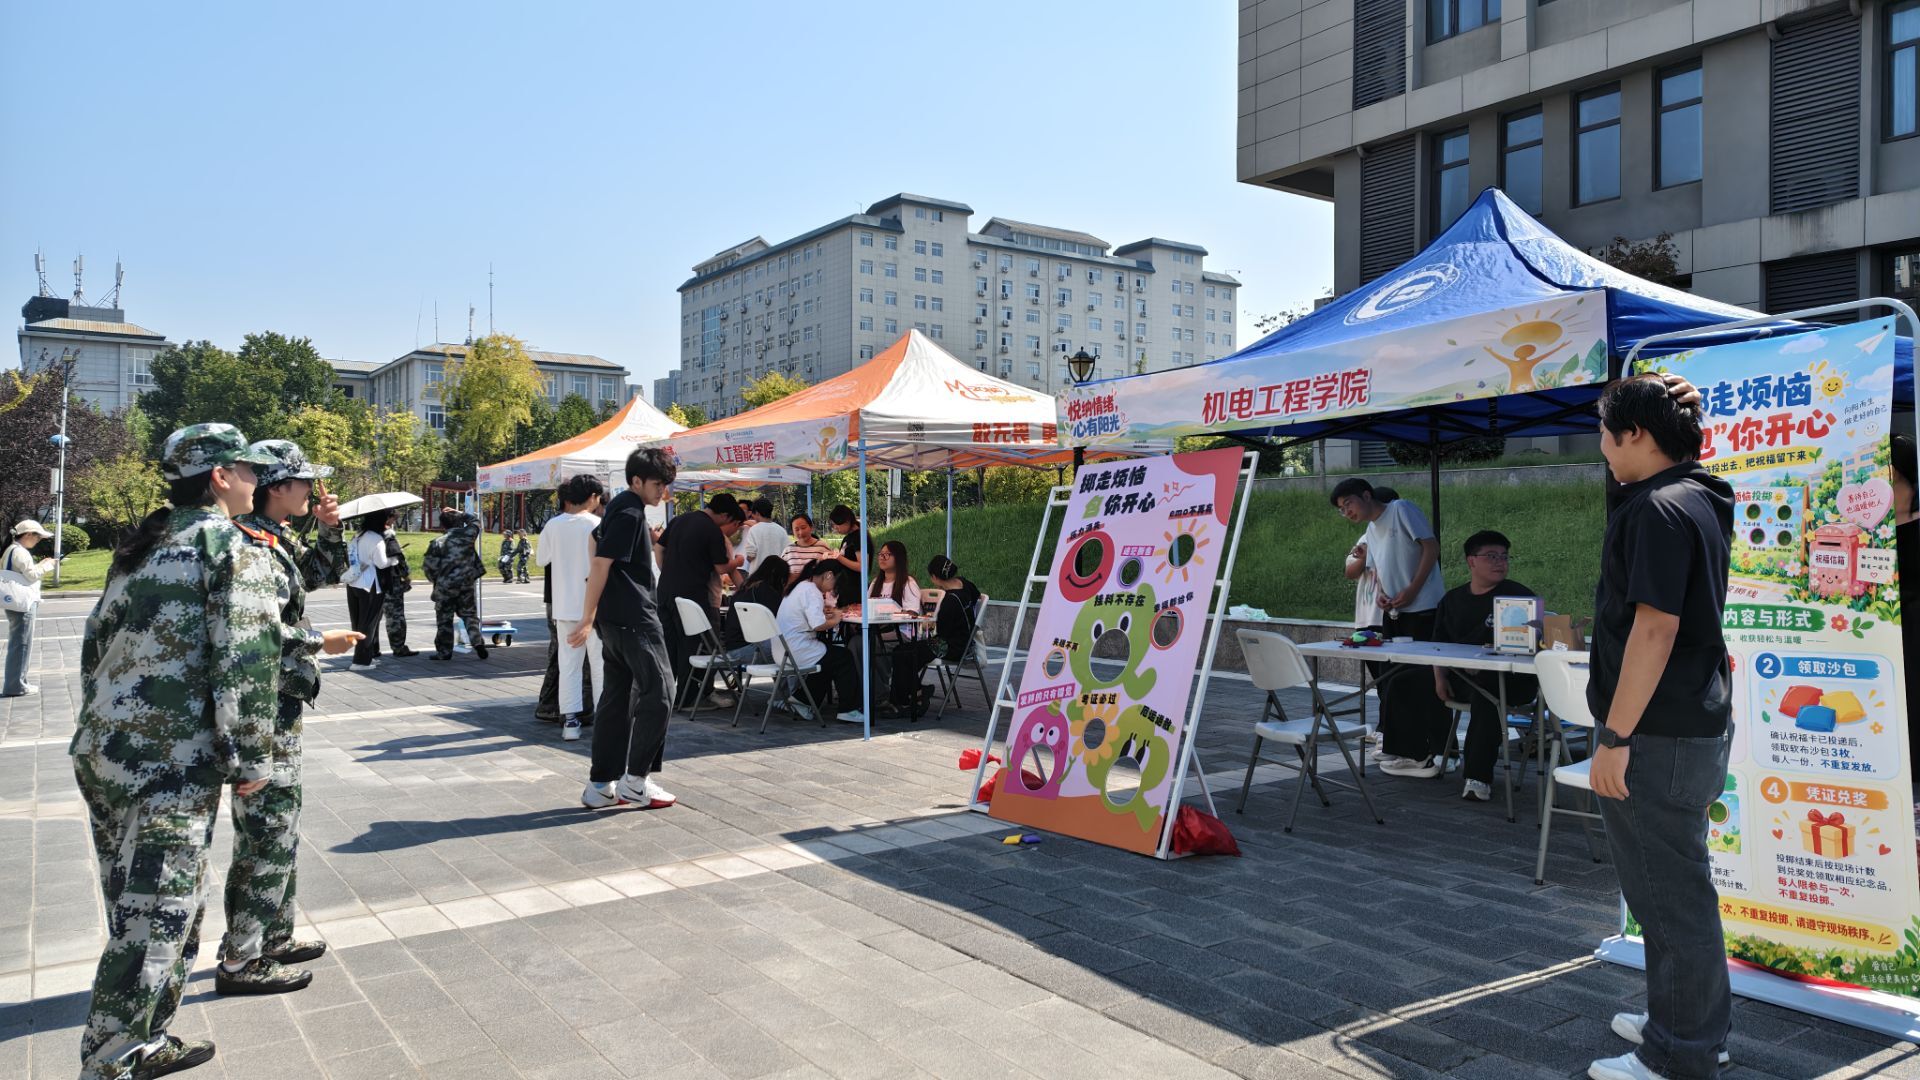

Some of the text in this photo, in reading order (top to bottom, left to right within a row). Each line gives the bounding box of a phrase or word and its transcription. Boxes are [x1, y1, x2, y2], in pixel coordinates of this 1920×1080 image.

[1201, 368, 1371, 424] 机电工程学院
[1844, 397, 1875, 414] 向阳而生
[1844, 404, 1888, 425] 做更好的自己
[1072, 414, 1120, 438] 心有阳光
[715, 441, 775, 463] 人工智能学院
[1079, 465, 1147, 494] 掷走烦恼
[1848, 489, 1876, 502] 善待自己
[1815, 553, 1845, 566] 祝福信箱
[1094, 594, 1146, 607] 挂科不存在
[1723, 608, 1812, 628] 内容与形式
[1762, 658, 1774, 674] 2
[1798, 661, 1857, 676] 领取沙包
[1081, 693, 1117, 705] 考证必过
[1767, 782, 1780, 798] 4
[1806, 786, 1868, 806] 凭证兑奖
[1776, 853, 1875, 876] 投掷结束后按现场计数
[1778, 888, 1835, 906] 不重复投掷。
